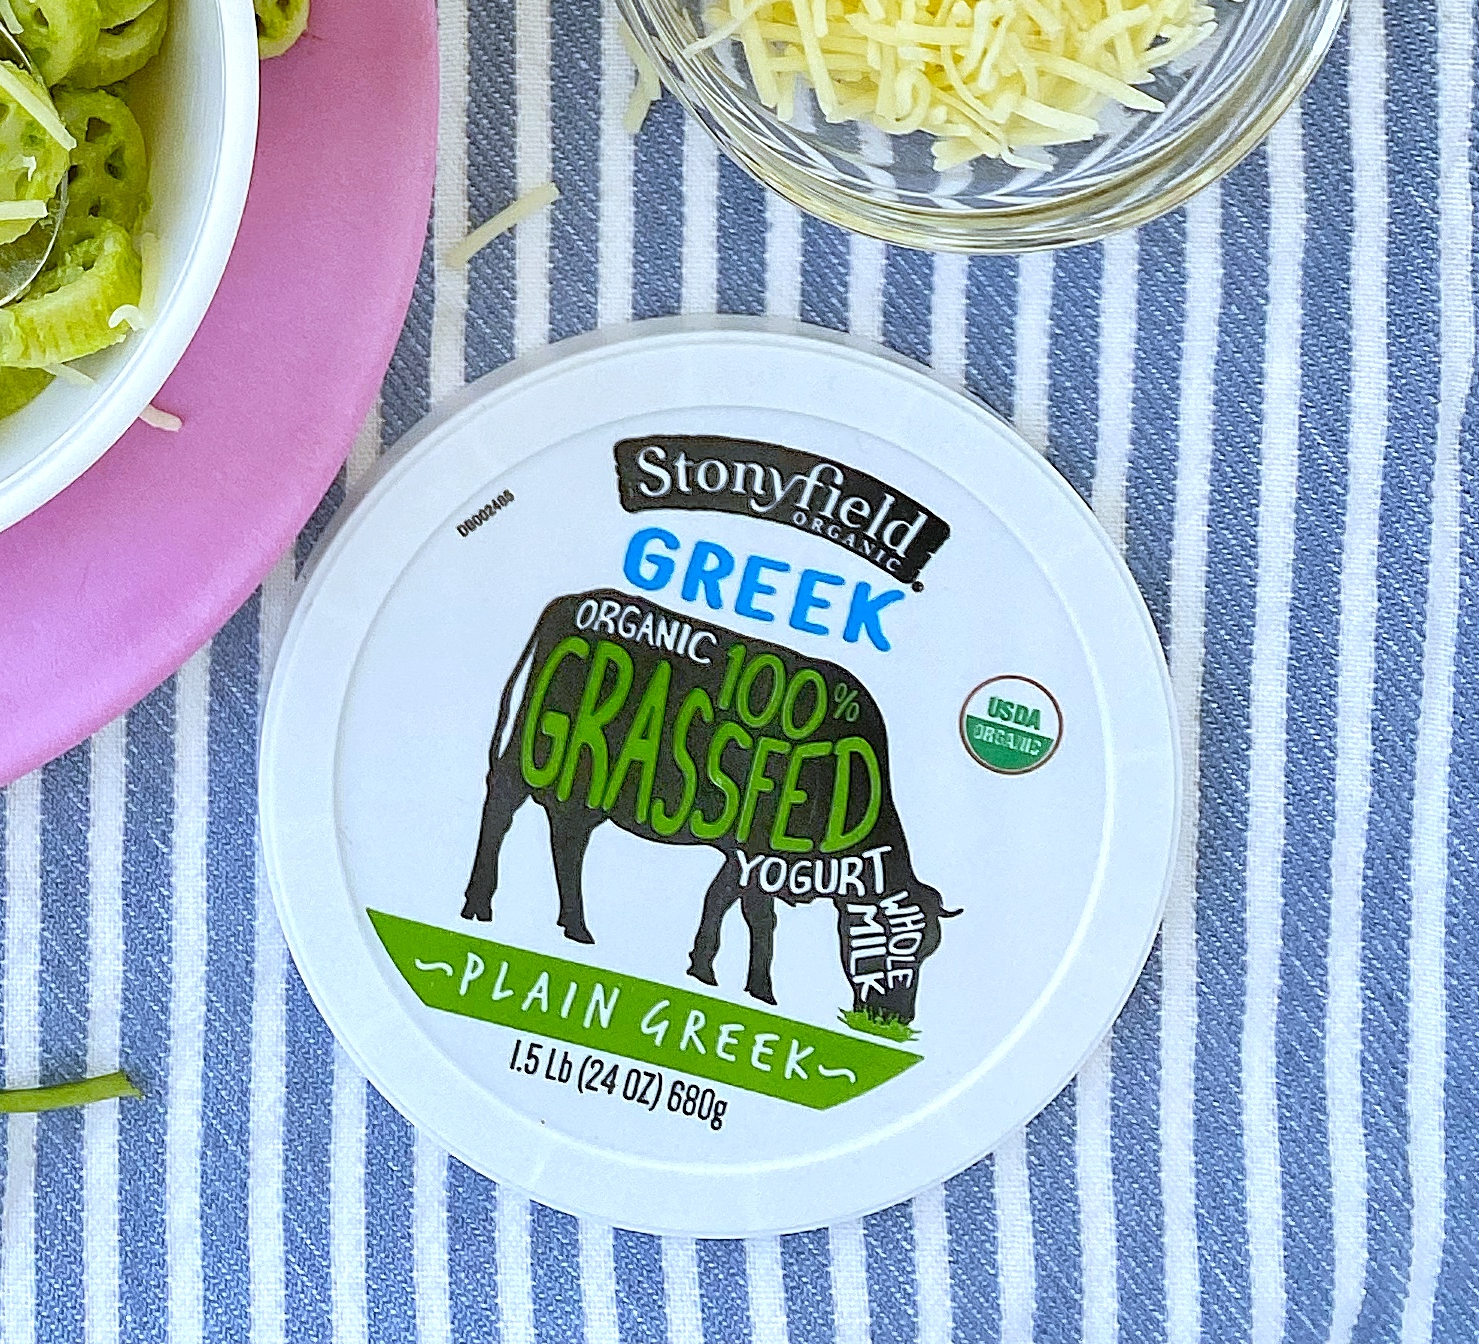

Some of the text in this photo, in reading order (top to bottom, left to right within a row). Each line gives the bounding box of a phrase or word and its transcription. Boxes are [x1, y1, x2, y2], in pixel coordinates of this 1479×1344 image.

[636, 445, 929, 559] Stonyfield
[792, 512, 902, 573] ORGANIC
[622, 526, 907, 653] GREEK
[575, 599, 860, 740] ORGANIC 100%
[987, 696, 1041, 731] USDA
[522, 635, 882, 853] GRASSFED
[972, 723, 1043, 756] ORGANIC
[736, 845, 892, 898] YOGURT
[846, 903, 888, 1003] MILK
[878, 890, 926, 990] WHOLE
[458, 952, 816, 1081] PLAIN GREEK
[509, 1039, 728, 1131] 1.5 Lb (24 OZ) 680g
